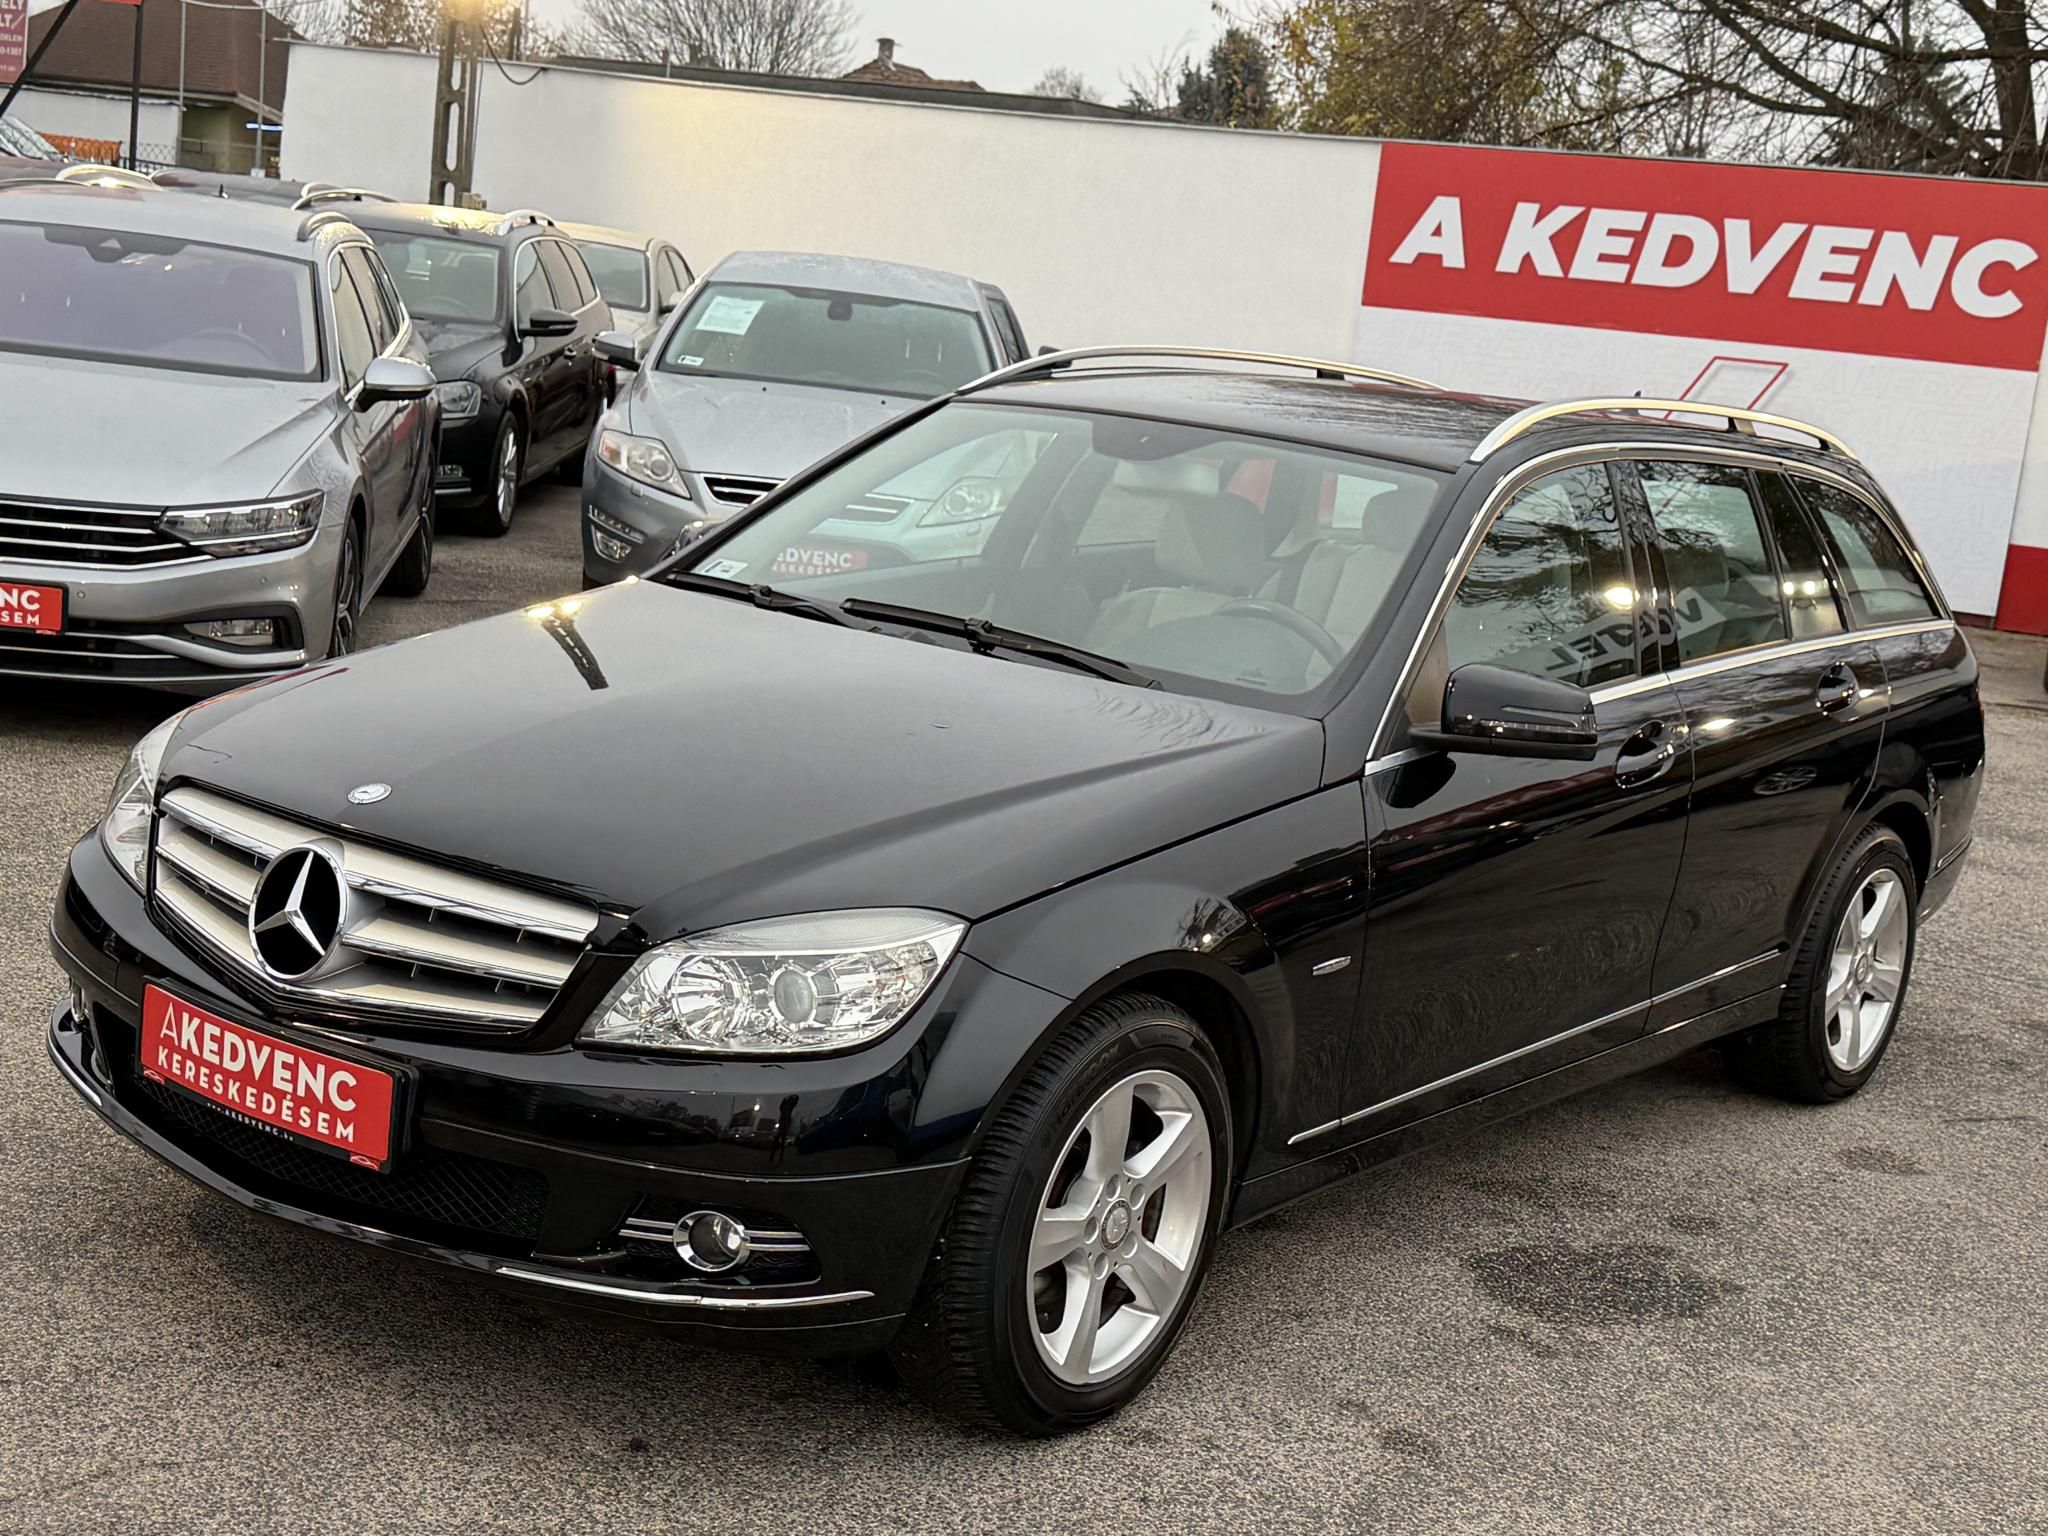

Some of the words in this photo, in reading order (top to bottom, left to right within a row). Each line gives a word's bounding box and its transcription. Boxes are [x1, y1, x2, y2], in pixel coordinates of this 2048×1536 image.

[1388, 195, 1466, 269] A
[1495, 202, 2039, 319] KEDVENC
[157, 1045, 355, 1143] KERESKEDÉSEM
